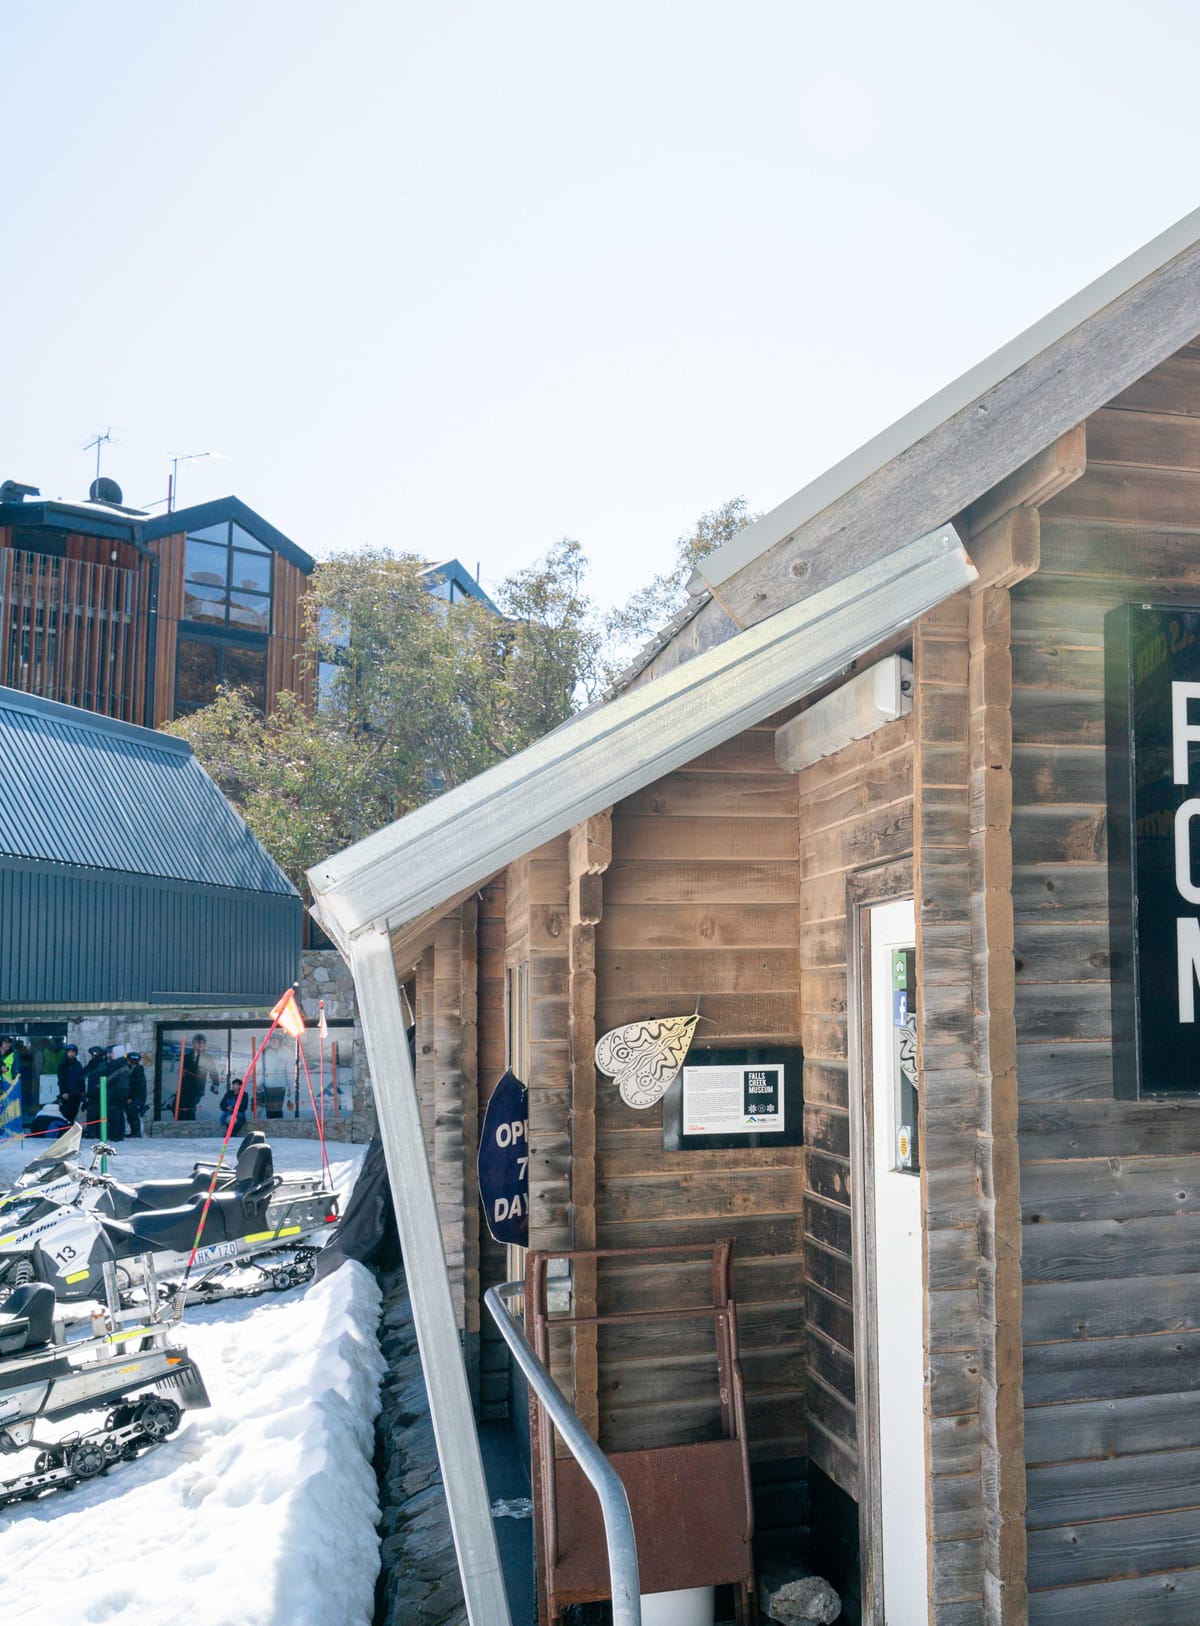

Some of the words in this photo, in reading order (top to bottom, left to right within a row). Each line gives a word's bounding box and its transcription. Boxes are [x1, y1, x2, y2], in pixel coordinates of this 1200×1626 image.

[748, 1072, 766, 1080] FALLS
[748, 1079, 767, 1087] CREEK
[748, 1085, 774, 1094] MUSEUM
[516, 1156, 528, 1181] 7
[16, 1221, 58, 1244] ski-doo
[55, 1245, 77, 1263] 13
